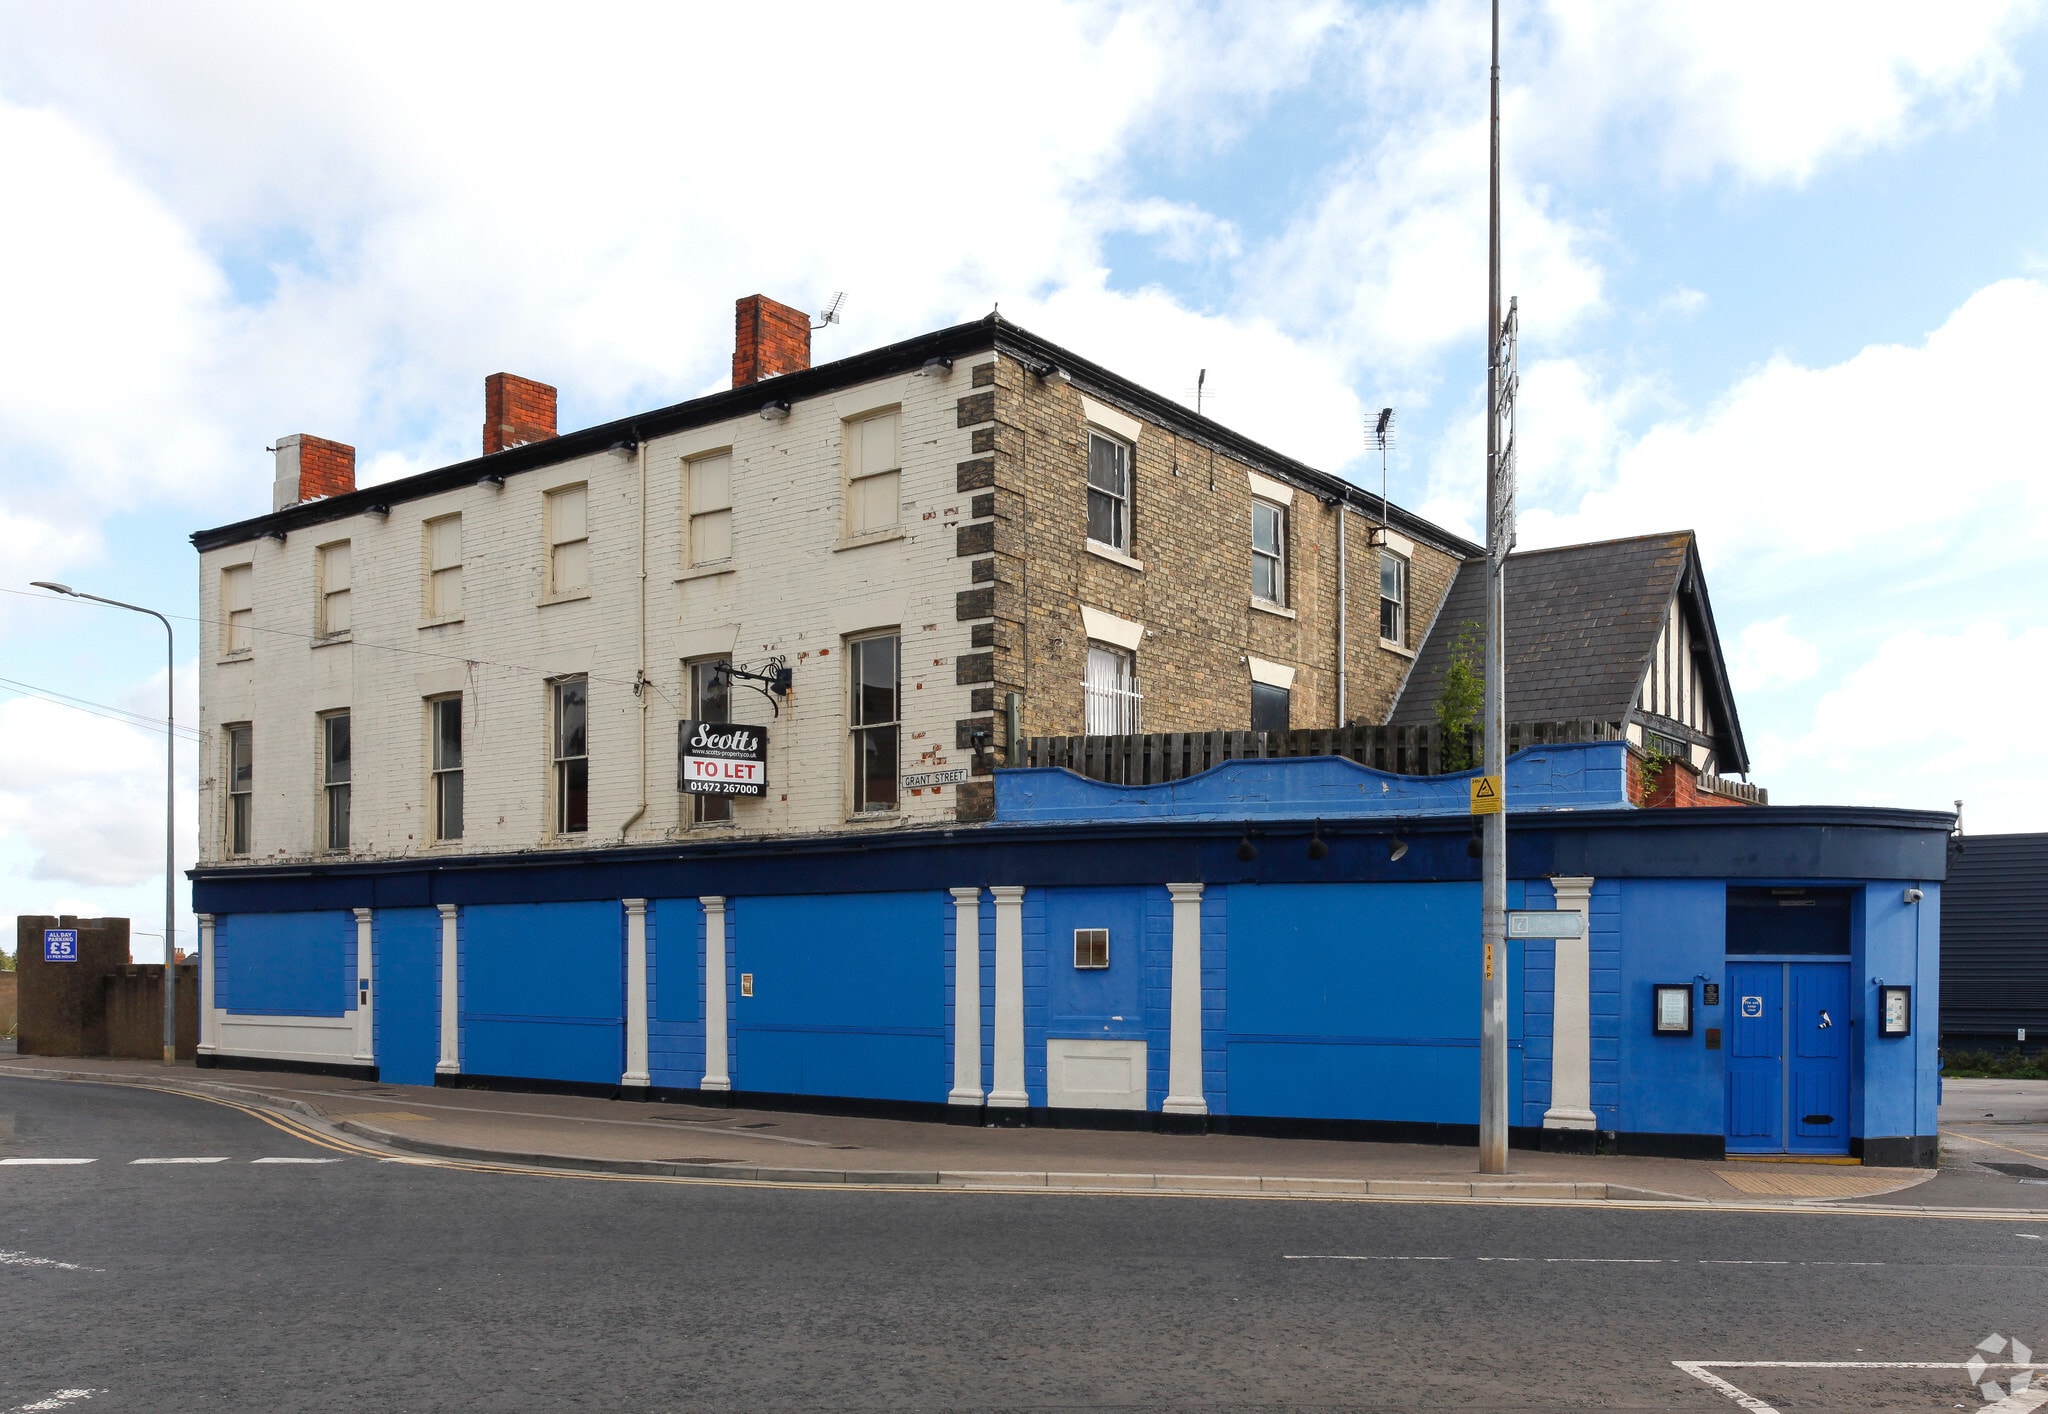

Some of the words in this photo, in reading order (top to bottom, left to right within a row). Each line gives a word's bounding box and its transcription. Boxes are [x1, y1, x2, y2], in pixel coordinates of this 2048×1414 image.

[690, 723, 758, 752] Scotts
[691, 748, 757, 759] www.scotts-property.co.uk
[693, 760, 718, 777] TO
[724, 763, 756, 780] LET
[905, 774, 931, 786] GRANT
[935, 770, 964, 783] STREET
[690, 781, 720, 792] 01472
[723, 783, 758, 794] 267000
[50, 941, 71, 955] £5
